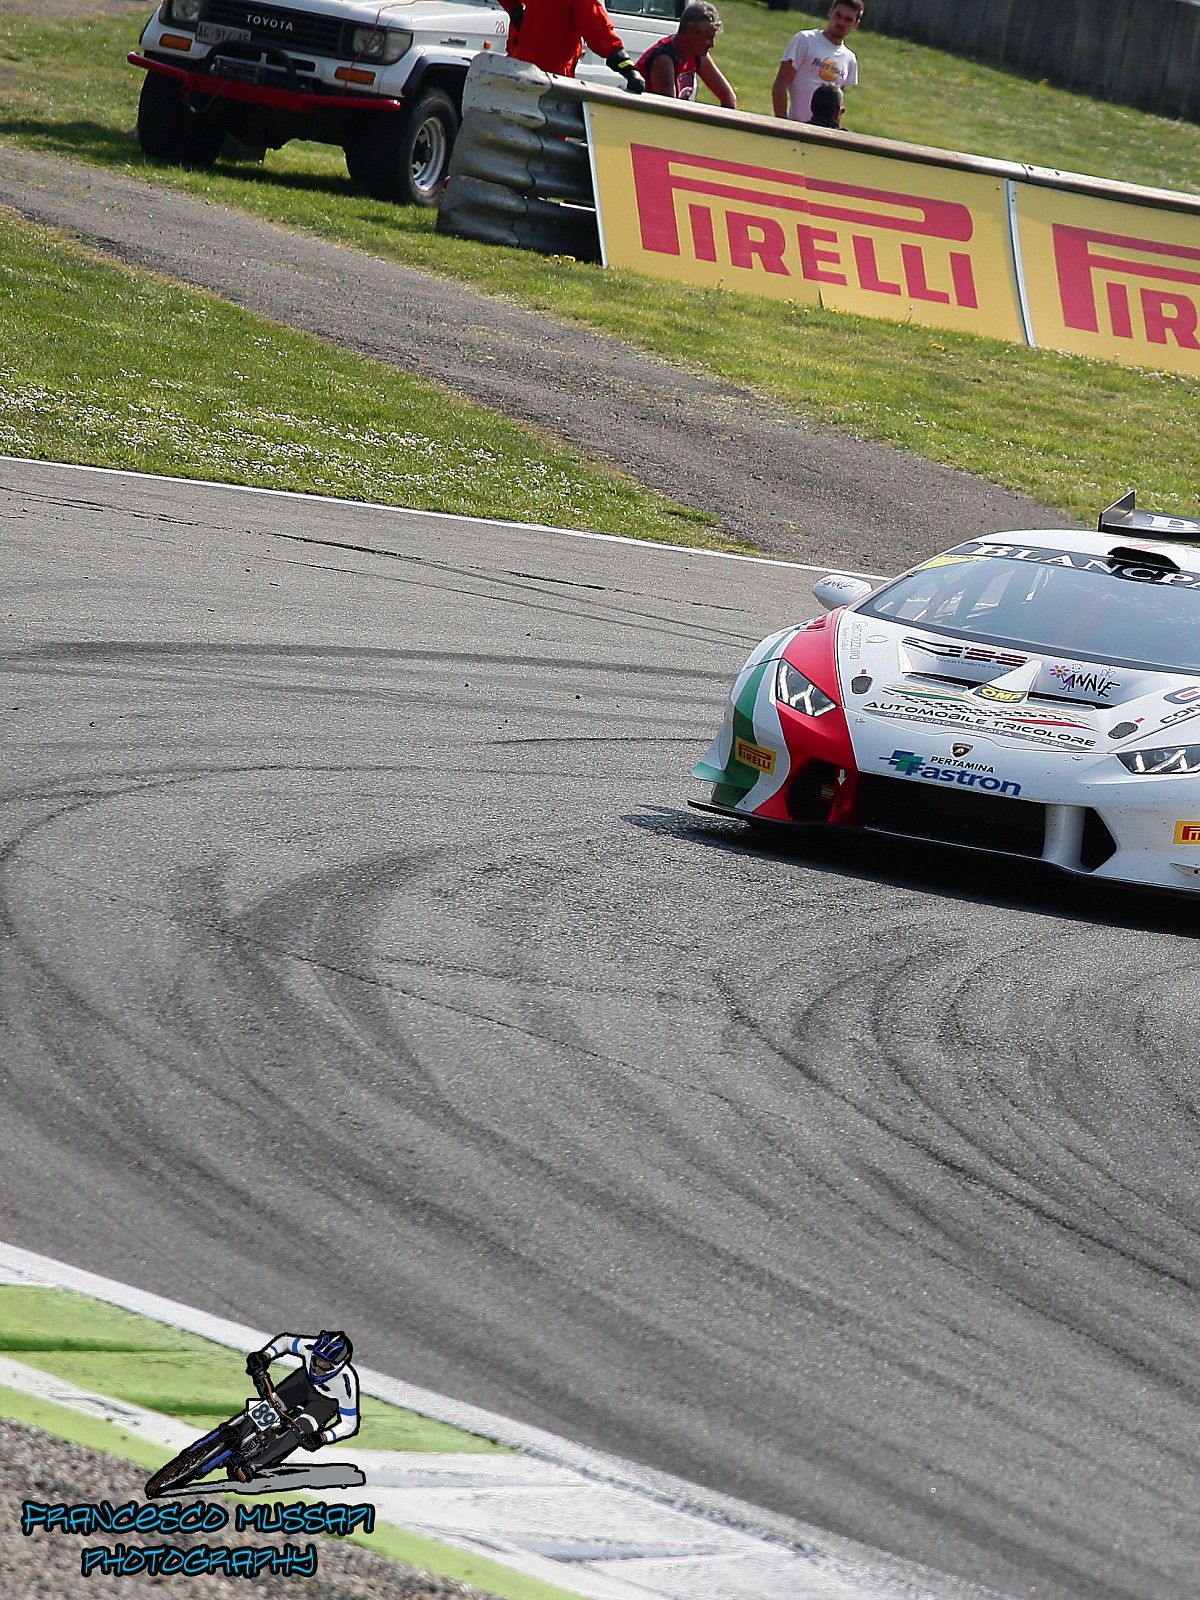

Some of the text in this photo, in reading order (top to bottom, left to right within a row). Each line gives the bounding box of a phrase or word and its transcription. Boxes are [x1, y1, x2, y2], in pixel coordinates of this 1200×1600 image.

[246, 14, 293, 32] TOYOTA
[496, 20, 506, 35] 28
[630, 142, 979, 310] PIRELLI
[981, 687, 1023, 701] OMP
[1062, 672, 1121, 698] ANNIE
[864, 701, 1098, 748] AUTOMOBILE TRICOLORE
[885, 711, 1066, 749] RESTAURO VENDITA CORSE
[738, 742, 772, 770] PIRELLI
[930, 756, 995, 774] PERTAMINA
[904, 762, 1023, 796] Fastron
